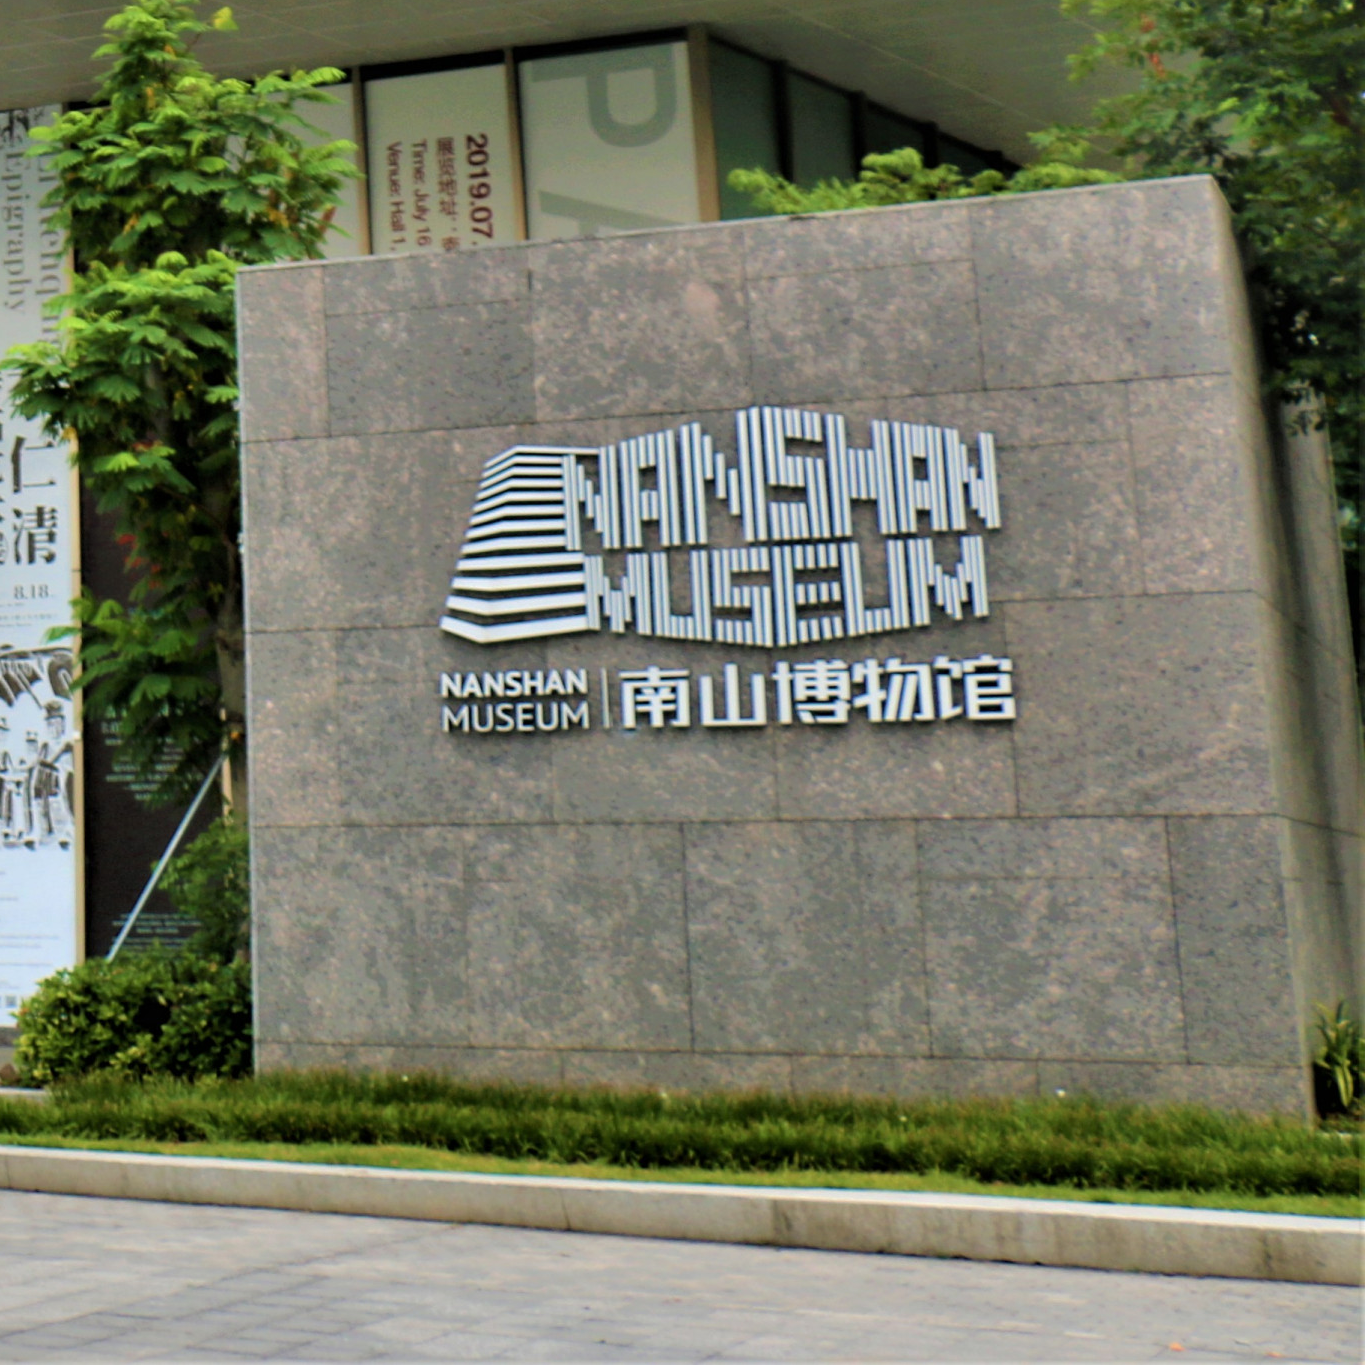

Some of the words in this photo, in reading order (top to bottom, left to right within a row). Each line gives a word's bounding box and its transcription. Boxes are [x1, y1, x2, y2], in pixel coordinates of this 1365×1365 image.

[1, 152, 32, 314] Epigraphy
[412, 189, 430, 221] July
[8, 372, 58, 565] 仁清
[562, 405, 1002, 551] NANSHAN
[13, 583, 50, 600] 8.18
[582, 534, 990, 649] MUSEUM
[440, 668, 589, 699] NANSHAN
[442, 700, 590, 733] MUSEUM
[619, 654, 1017, 729] 南山博物馆
